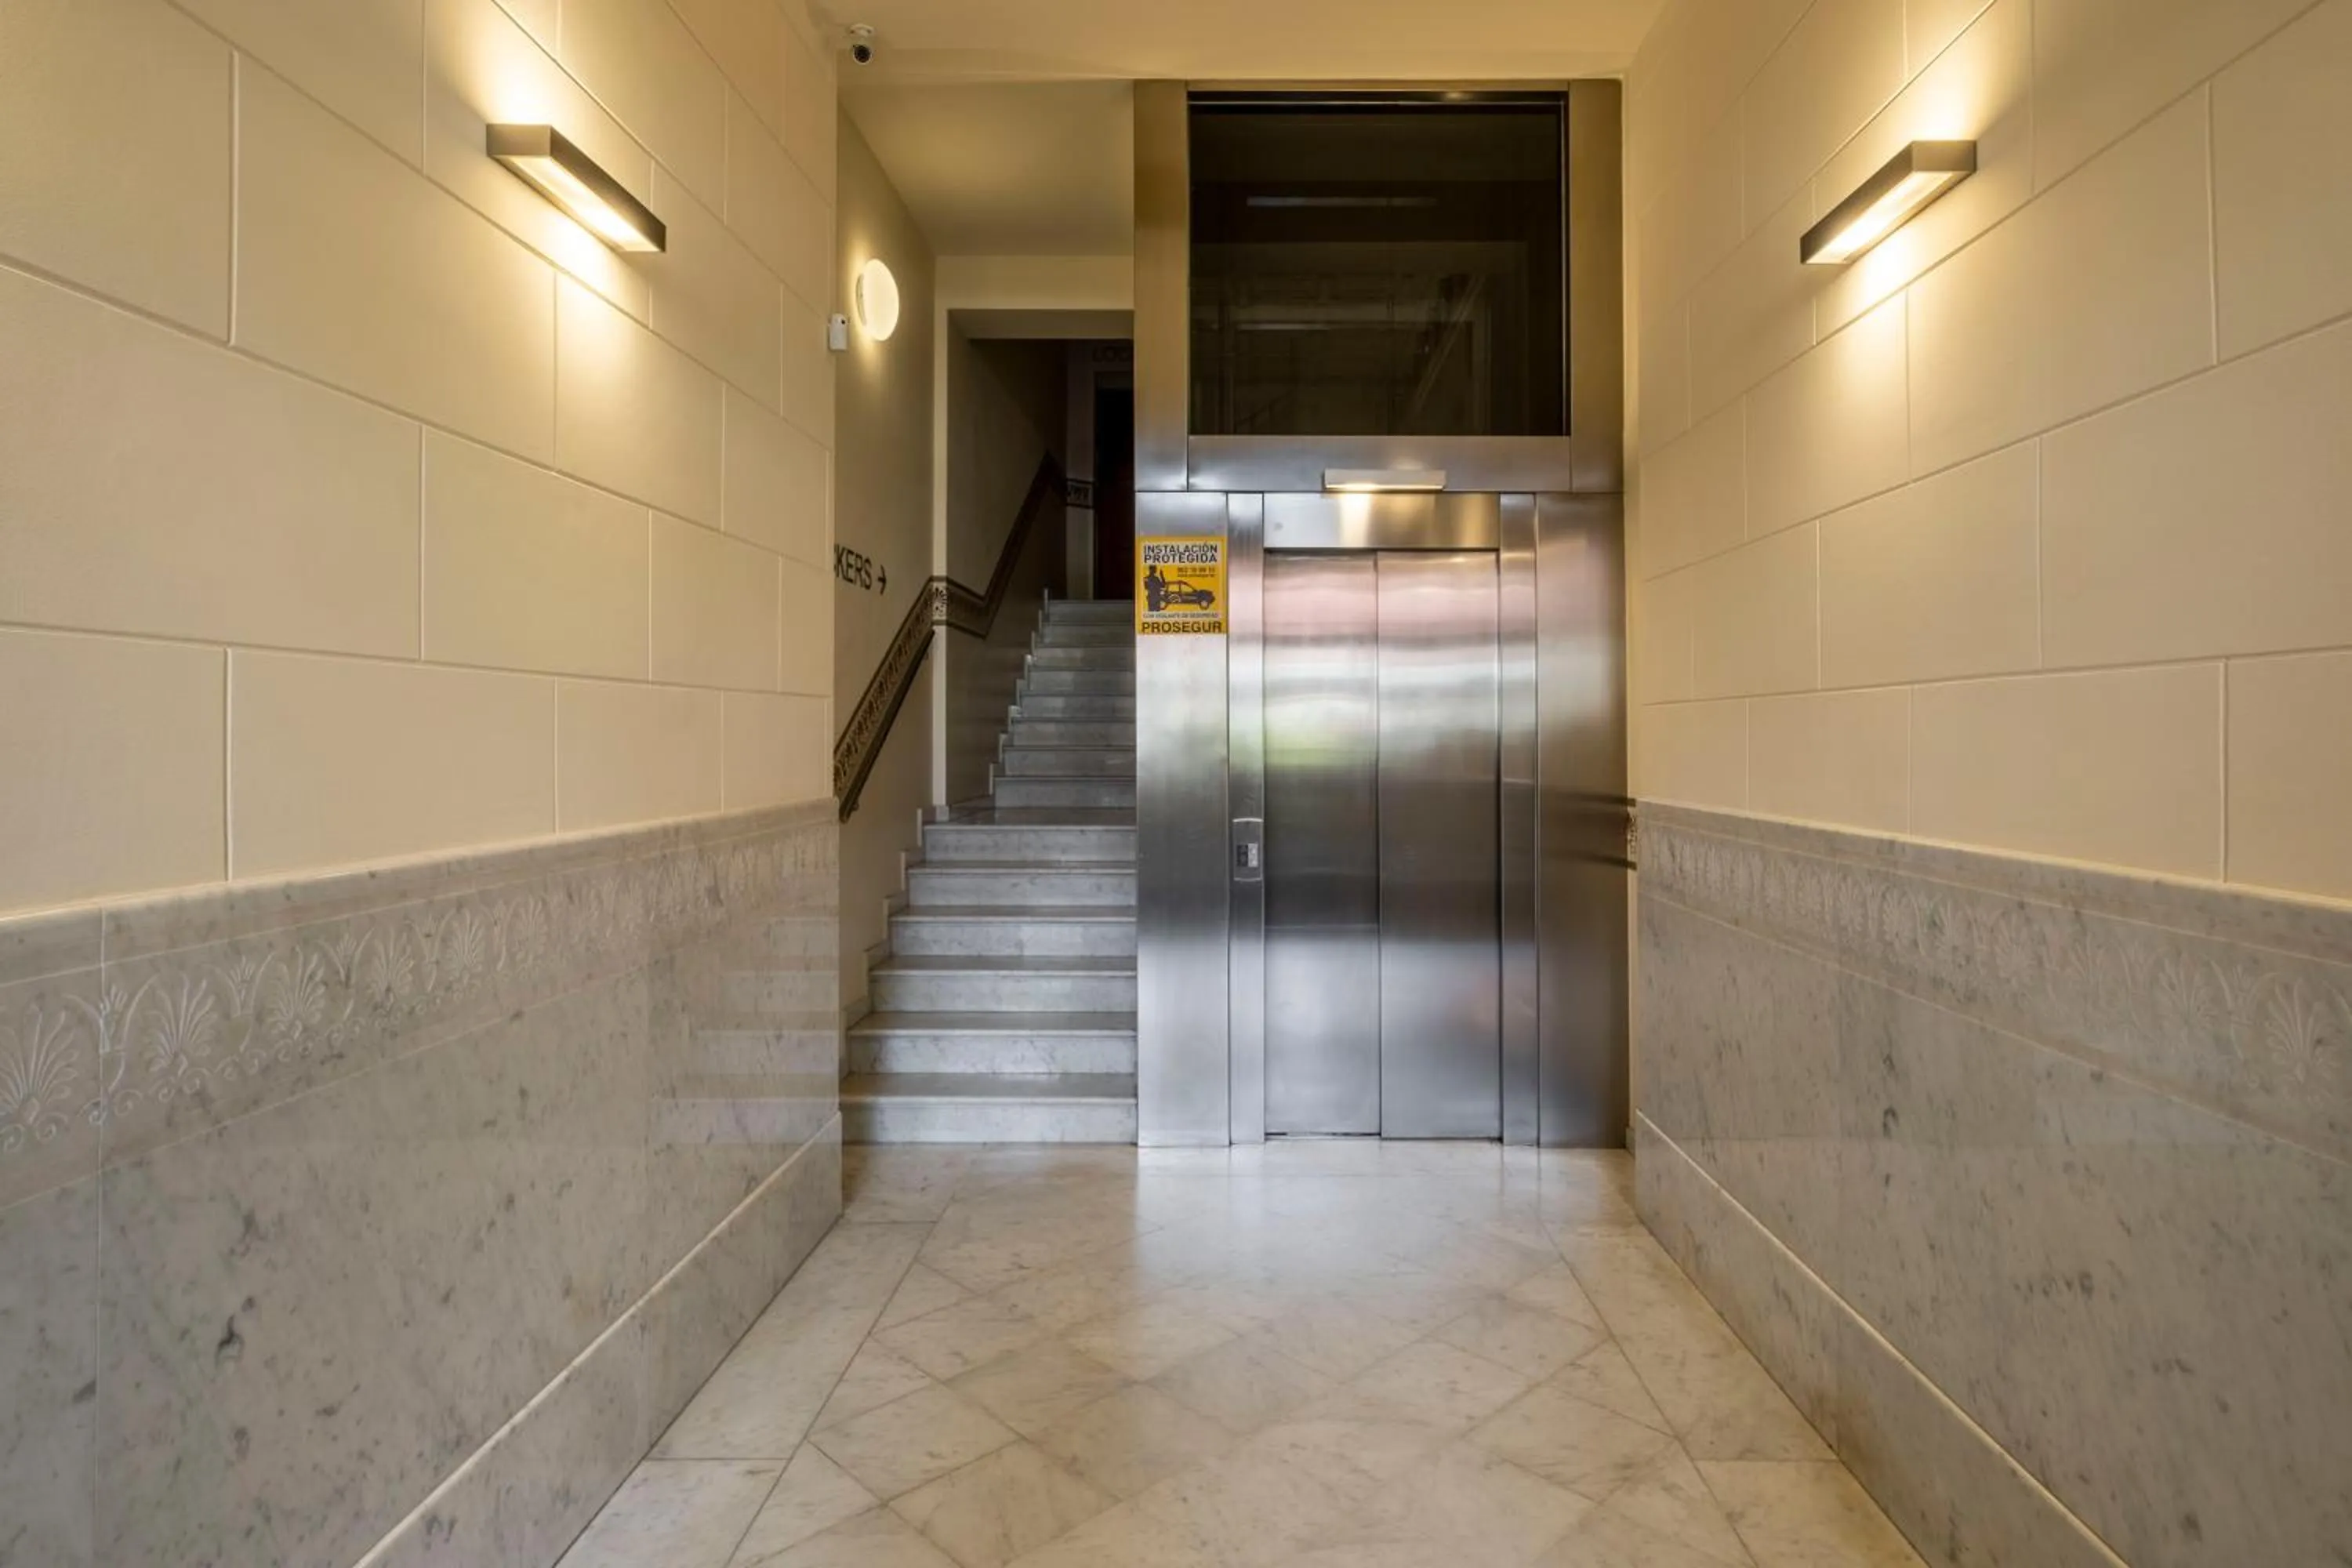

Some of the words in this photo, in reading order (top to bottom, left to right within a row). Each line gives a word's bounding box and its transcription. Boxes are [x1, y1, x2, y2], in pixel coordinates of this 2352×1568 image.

[1144, 543, 1218, 554] INSTALACIÓN
[1144, 554, 1218, 564] PROTEGIDA
[834, 544, 872, 590] KERS
[1142, 621, 1221, 633] PROSEGUR
